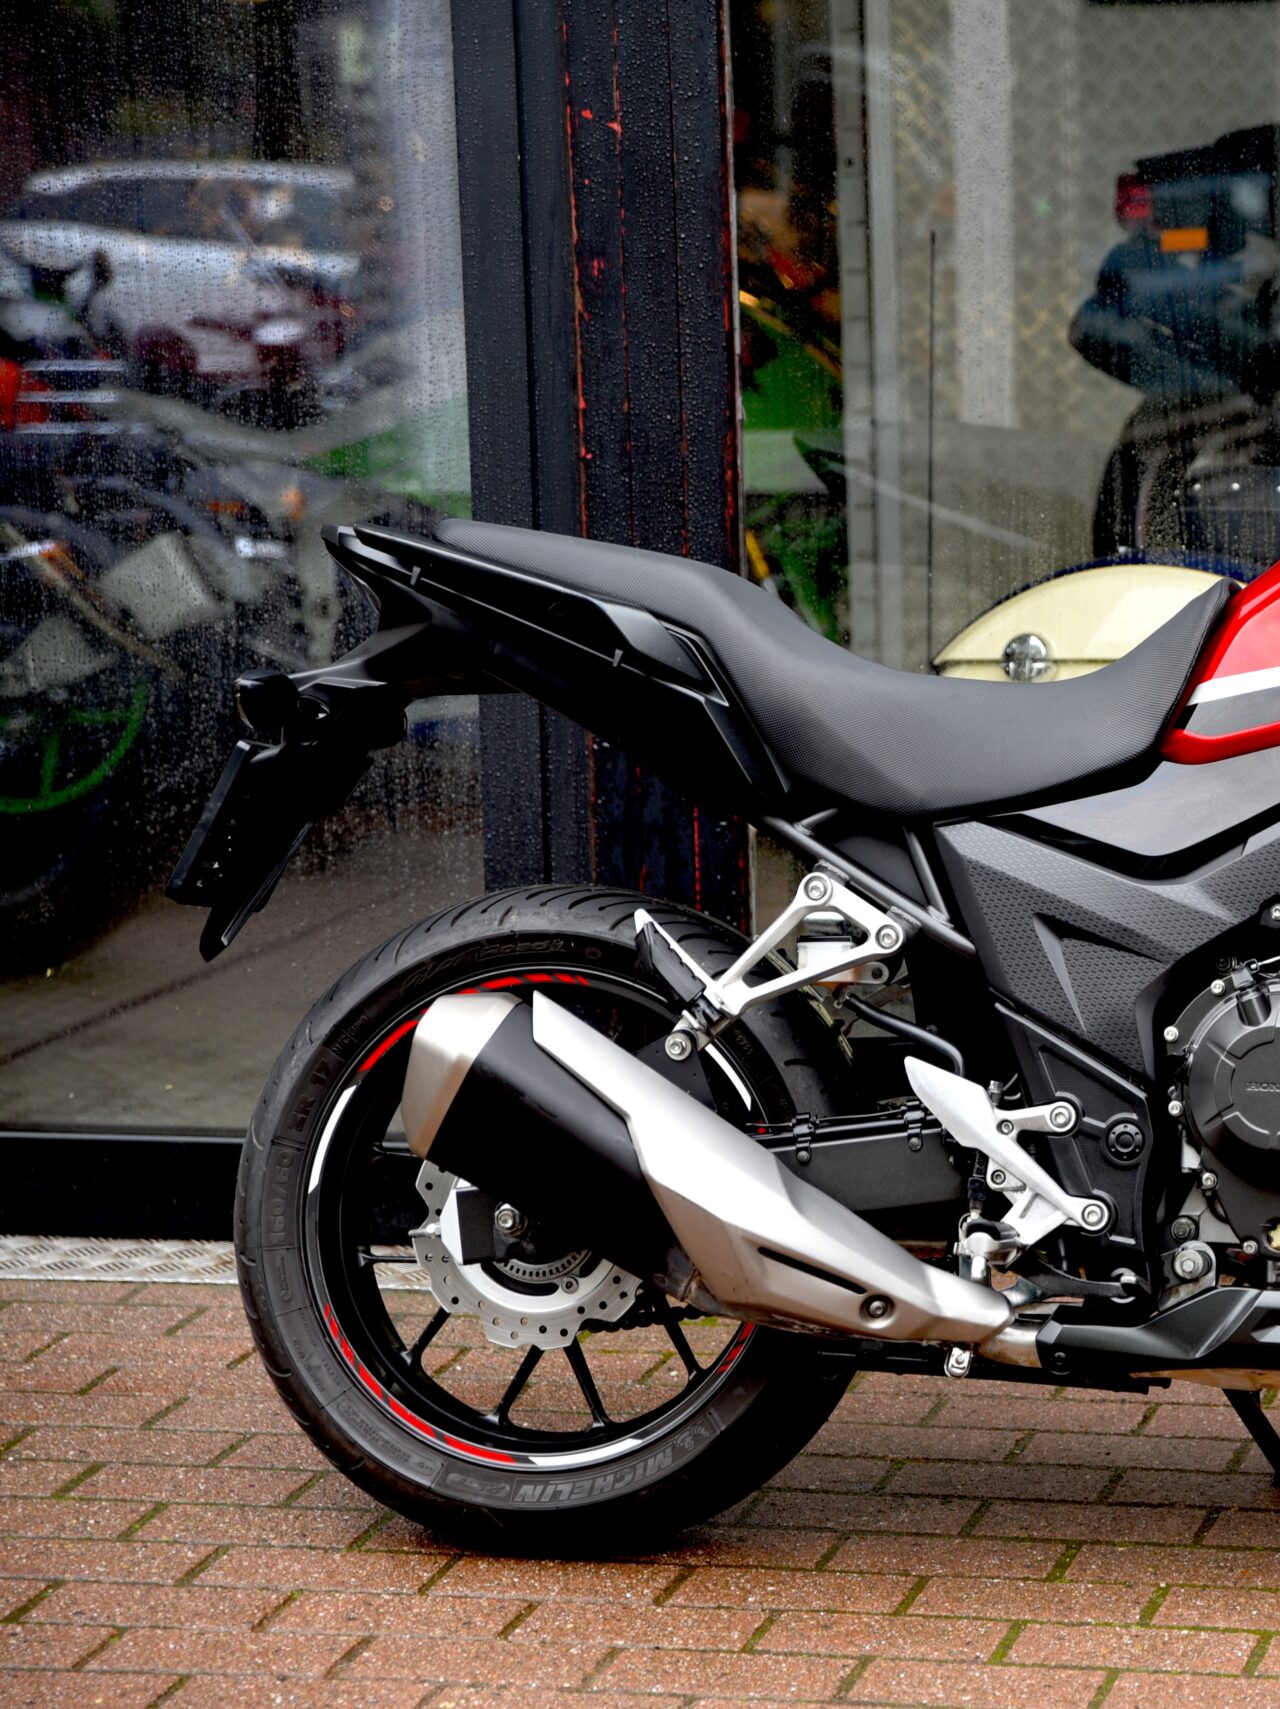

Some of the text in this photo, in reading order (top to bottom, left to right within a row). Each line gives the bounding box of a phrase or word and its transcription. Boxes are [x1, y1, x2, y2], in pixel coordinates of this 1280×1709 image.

[270, 1151, 294, 1244] 160/60
[288, 1095, 316, 1132] ZR
[515, 1447, 673, 1502] MICHELIN
